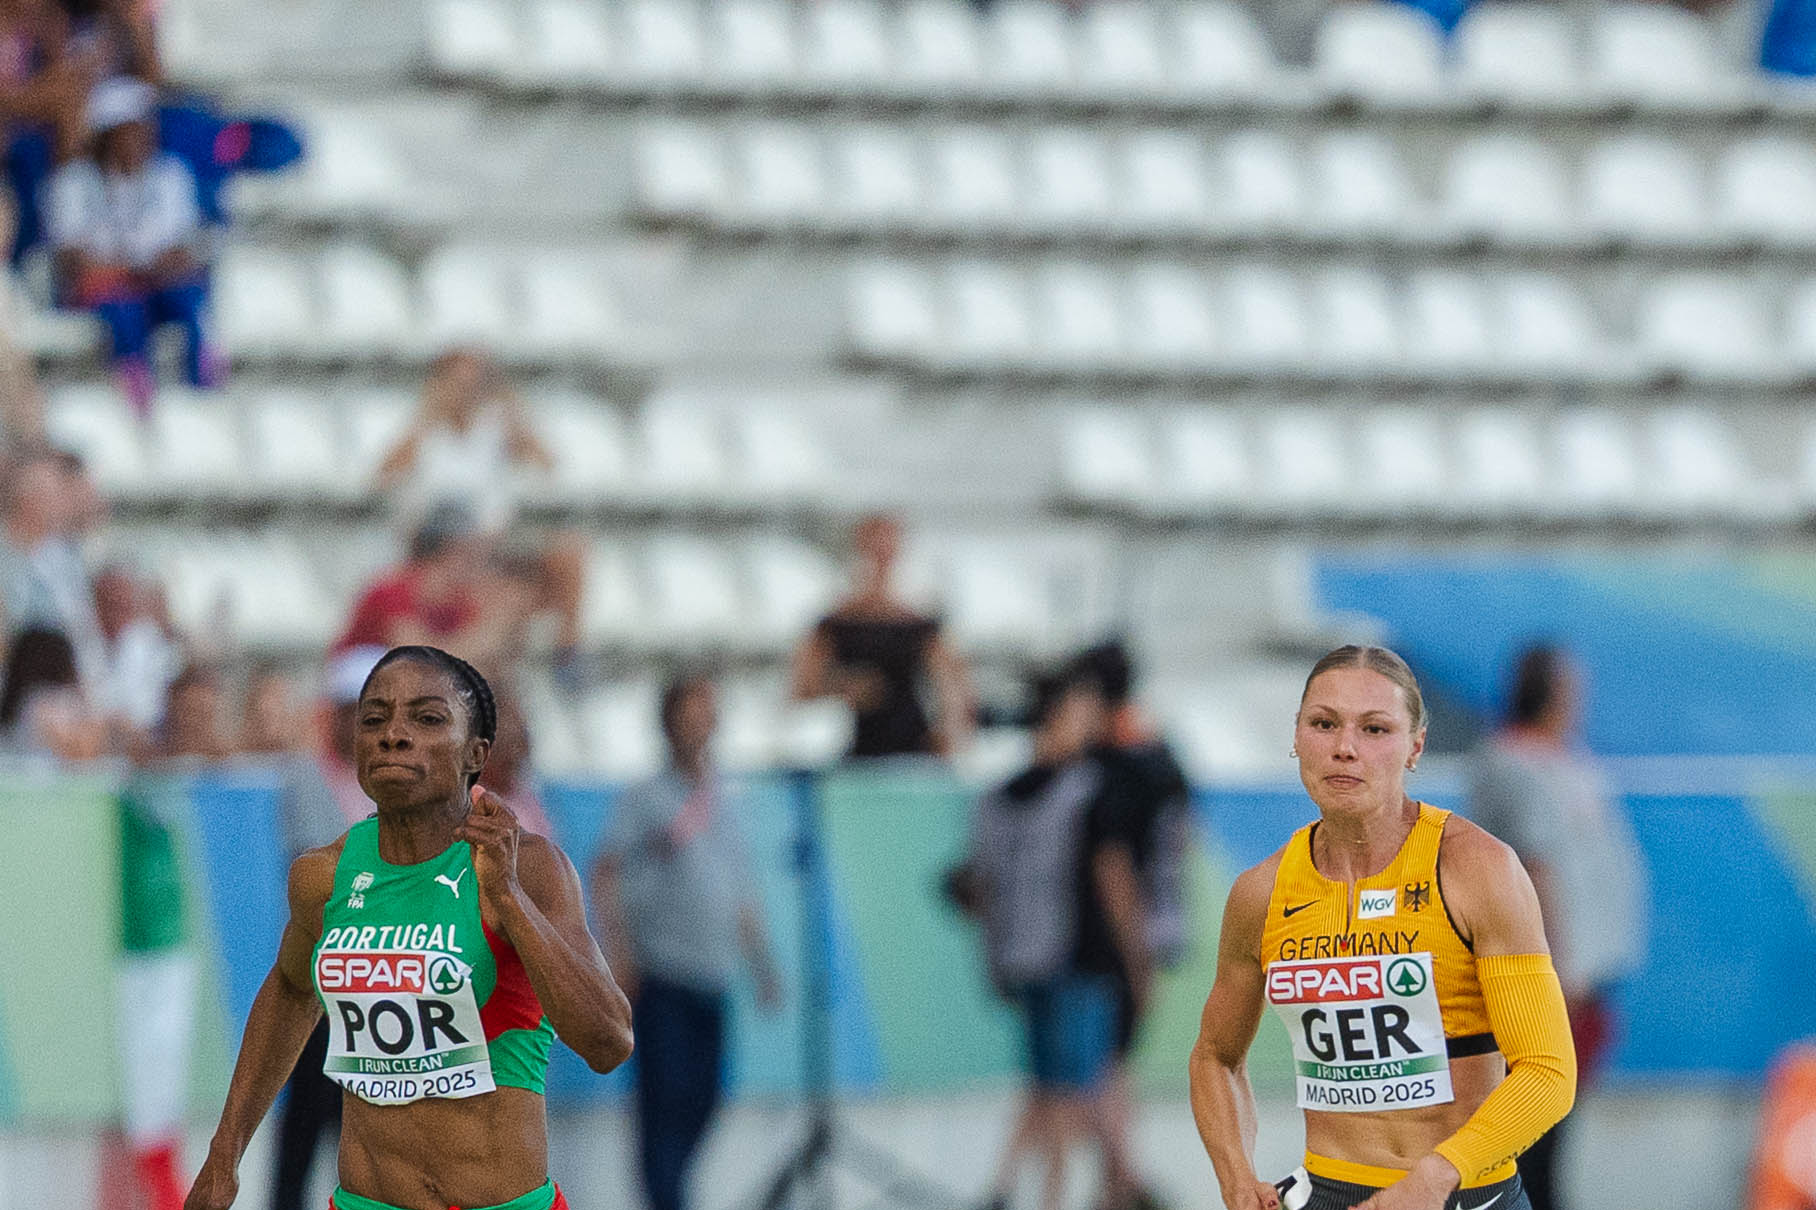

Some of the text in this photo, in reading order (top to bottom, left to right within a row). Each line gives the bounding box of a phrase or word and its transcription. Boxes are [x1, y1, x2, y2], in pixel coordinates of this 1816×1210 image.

[347, 898, 364, 909] FPA
[1360, 895, 1395, 912] WGV
[322, 923, 464, 954] PORTUGAL
[1279, 930, 1420, 962] GERMANY
[319, 958, 423, 988] SPAR
[1270, 966, 1382, 1000] SPAR
[335, 999, 470, 1056] POR
[1301, 1003, 1424, 1063] GER
[365, 1059, 390, 1073] RUN
[422, 1069, 477, 1097] 2025
[1306, 1078, 1436, 1106] MADRID 2025
